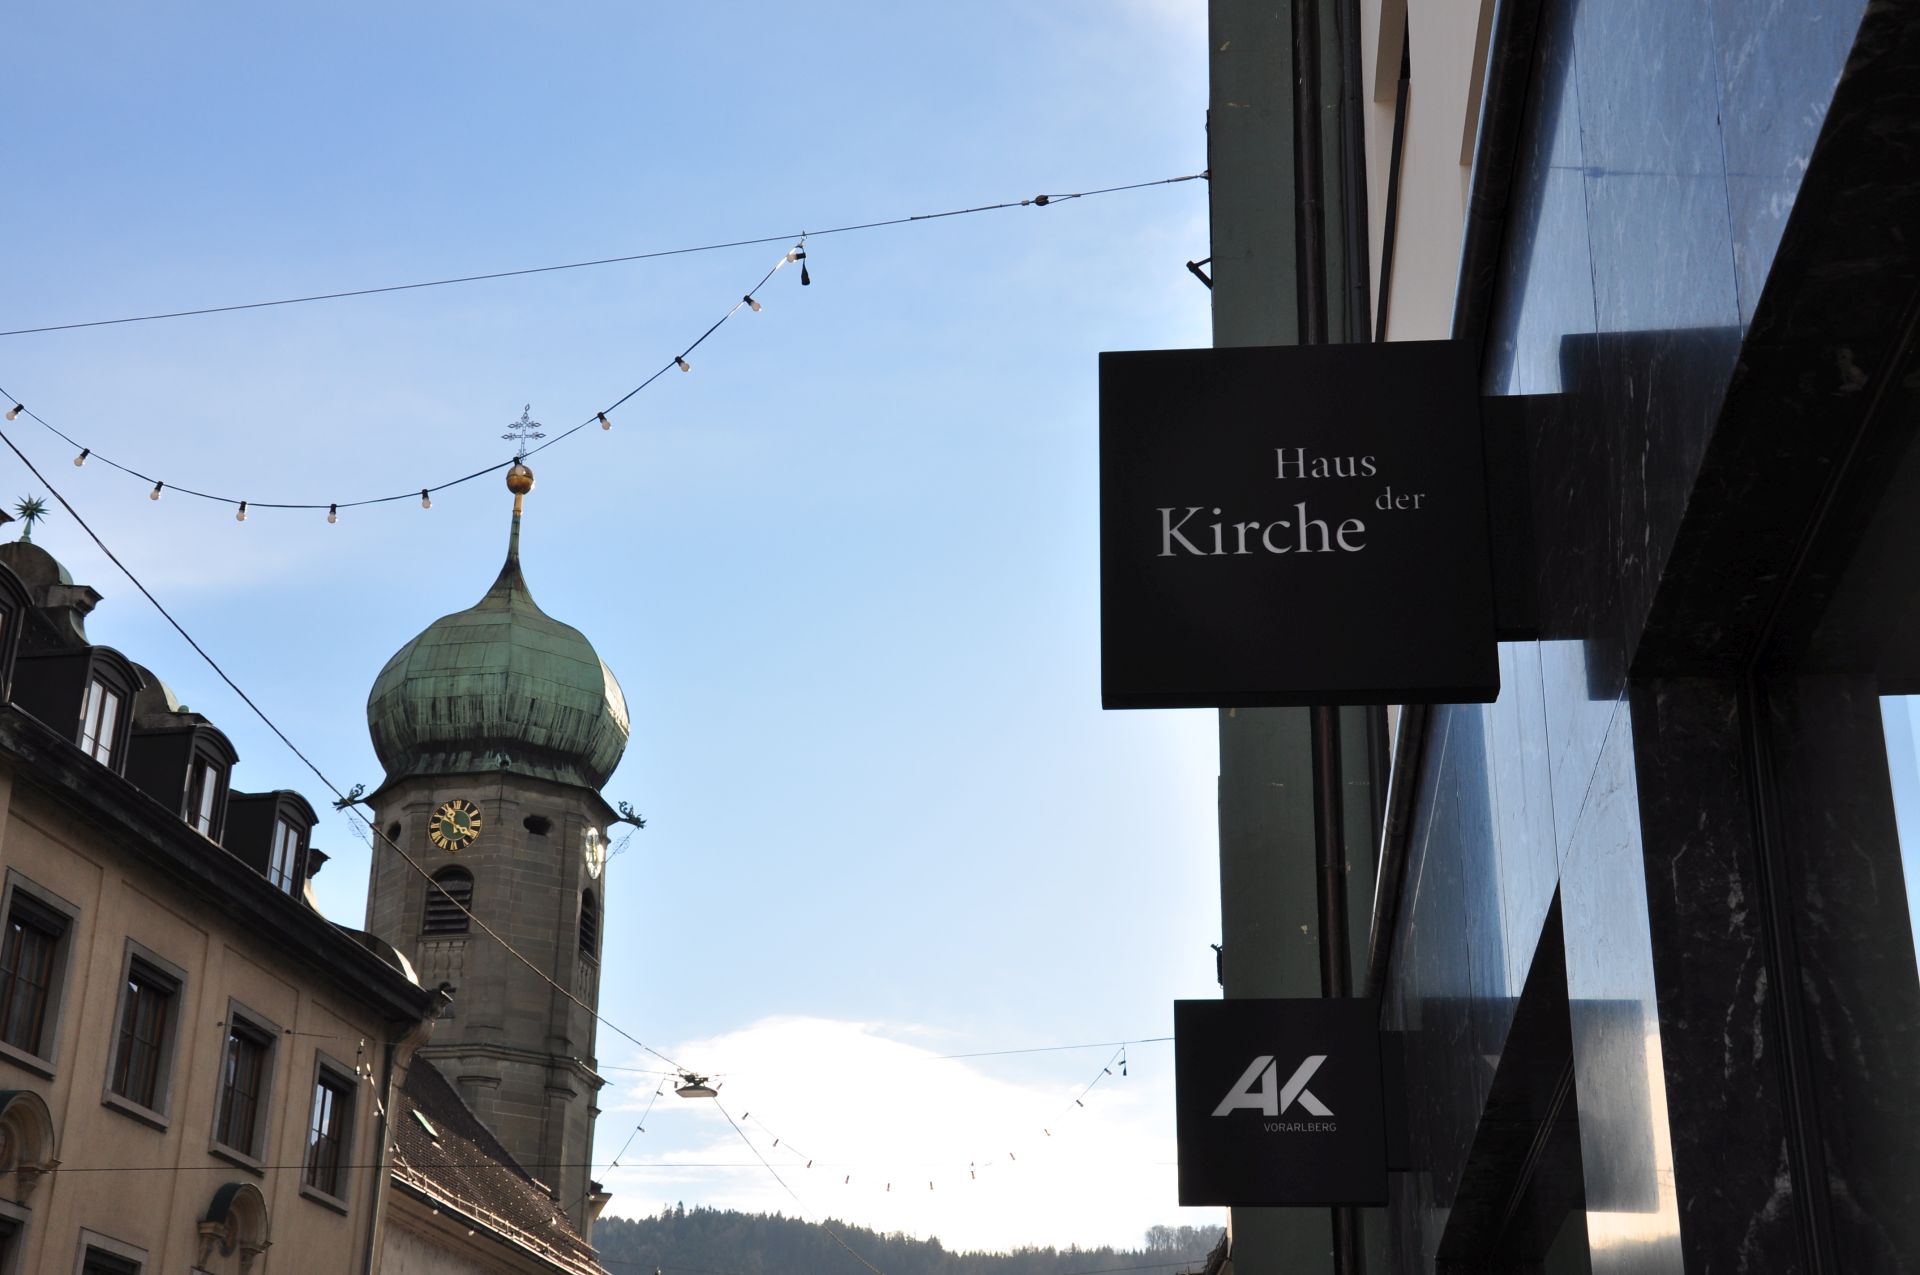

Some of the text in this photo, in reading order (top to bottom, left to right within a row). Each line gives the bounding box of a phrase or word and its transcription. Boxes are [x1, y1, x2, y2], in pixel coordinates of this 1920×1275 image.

[1275, 447, 1378, 479] Haus
[1374, 486, 1426, 511] der
[1157, 501, 1367, 557] Kirche
[1211, 1055, 1335, 1116] AK
[1263, 1122, 1337, 1133] VORARLBERG
